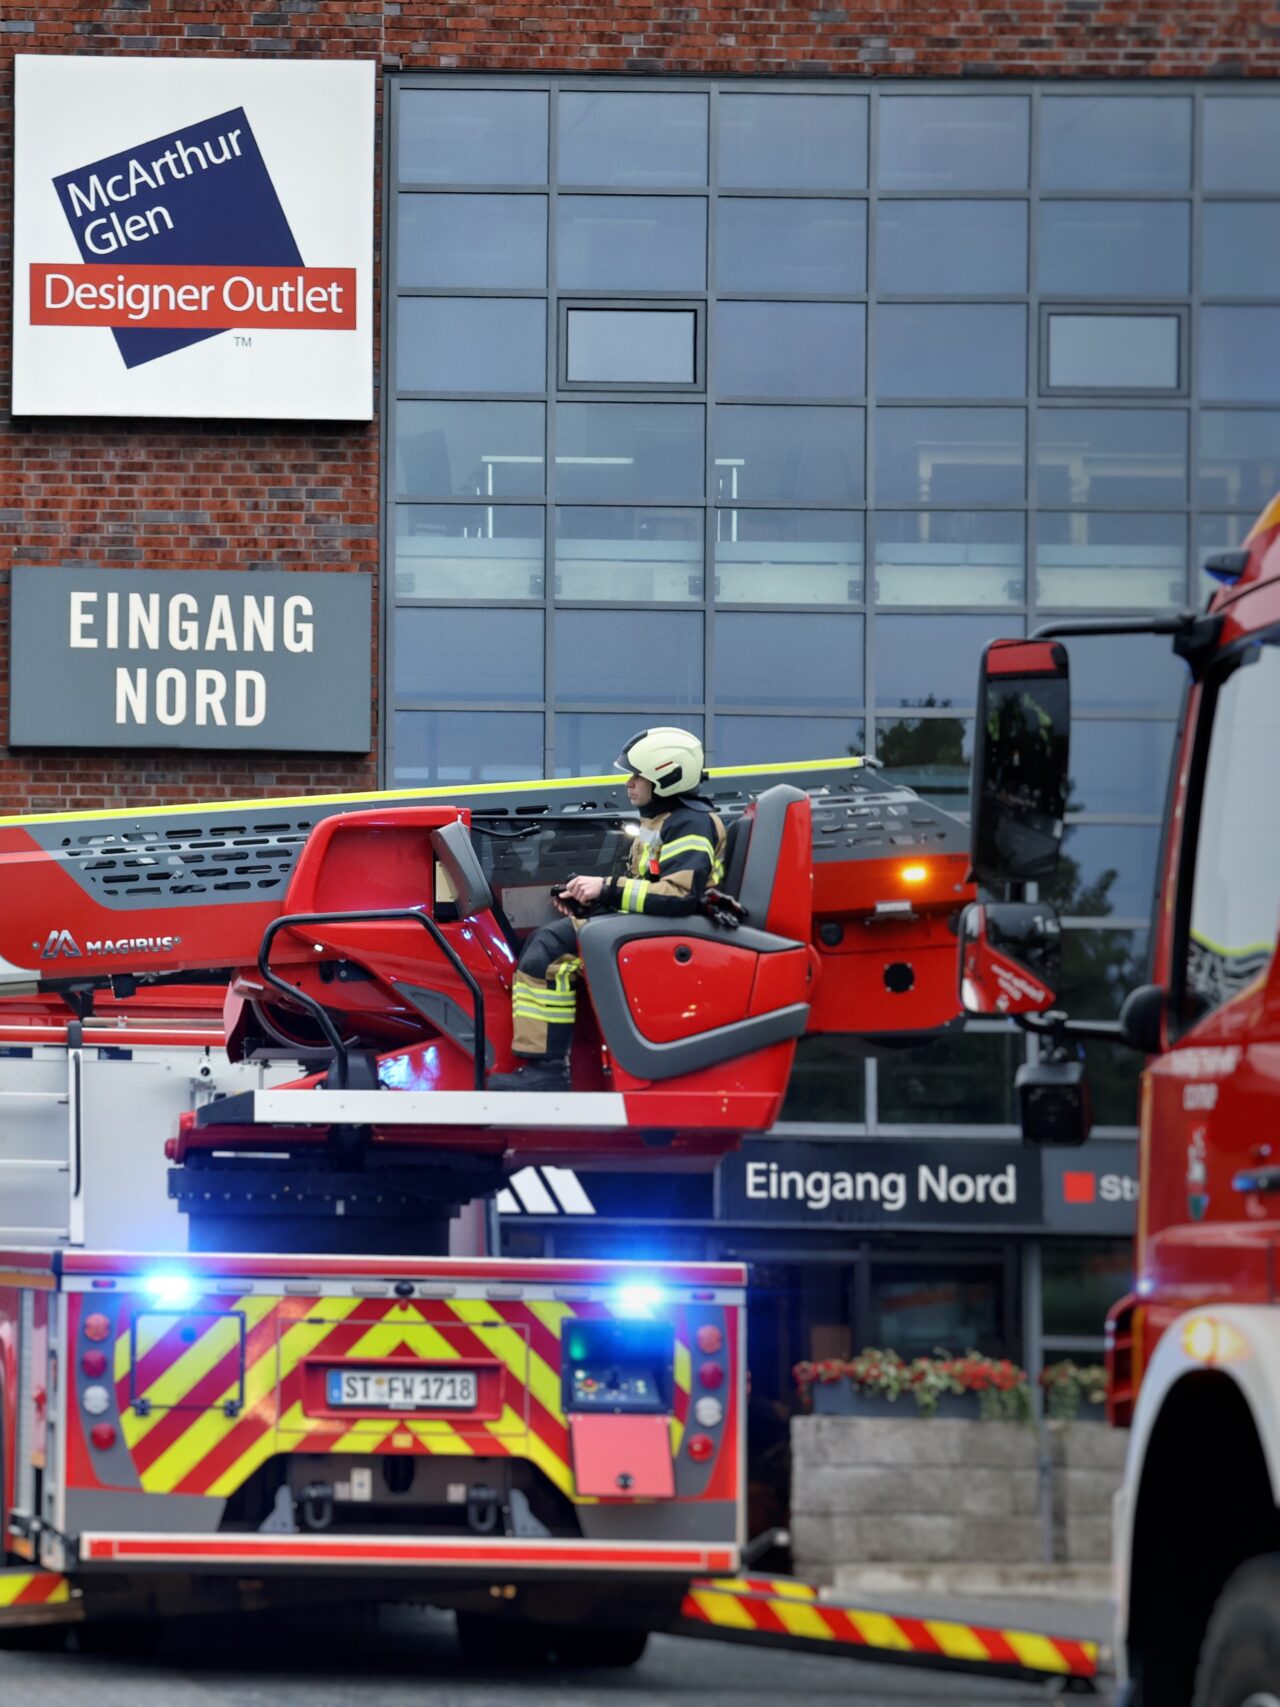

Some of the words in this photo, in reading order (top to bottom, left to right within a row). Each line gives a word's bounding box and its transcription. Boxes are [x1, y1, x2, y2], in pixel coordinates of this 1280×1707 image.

[67, 128, 243, 217] McArthur
[84, 206, 174, 255] Glen
[44, 273, 214, 320] Designer
[222, 276, 343, 313] Outlet
[70, 591, 314, 652] EINGANG
[115, 667, 267, 727] NORD
[85, 936, 174, 956] MAGIRUS
[746, 1162, 907, 1211] Eingang
[918, 1164, 1017, 1204] Nord
[345, 1376, 371, 1398] ST
[387, 1377, 415, 1399] FW
[421, 1377, 471, 1400] 1718
